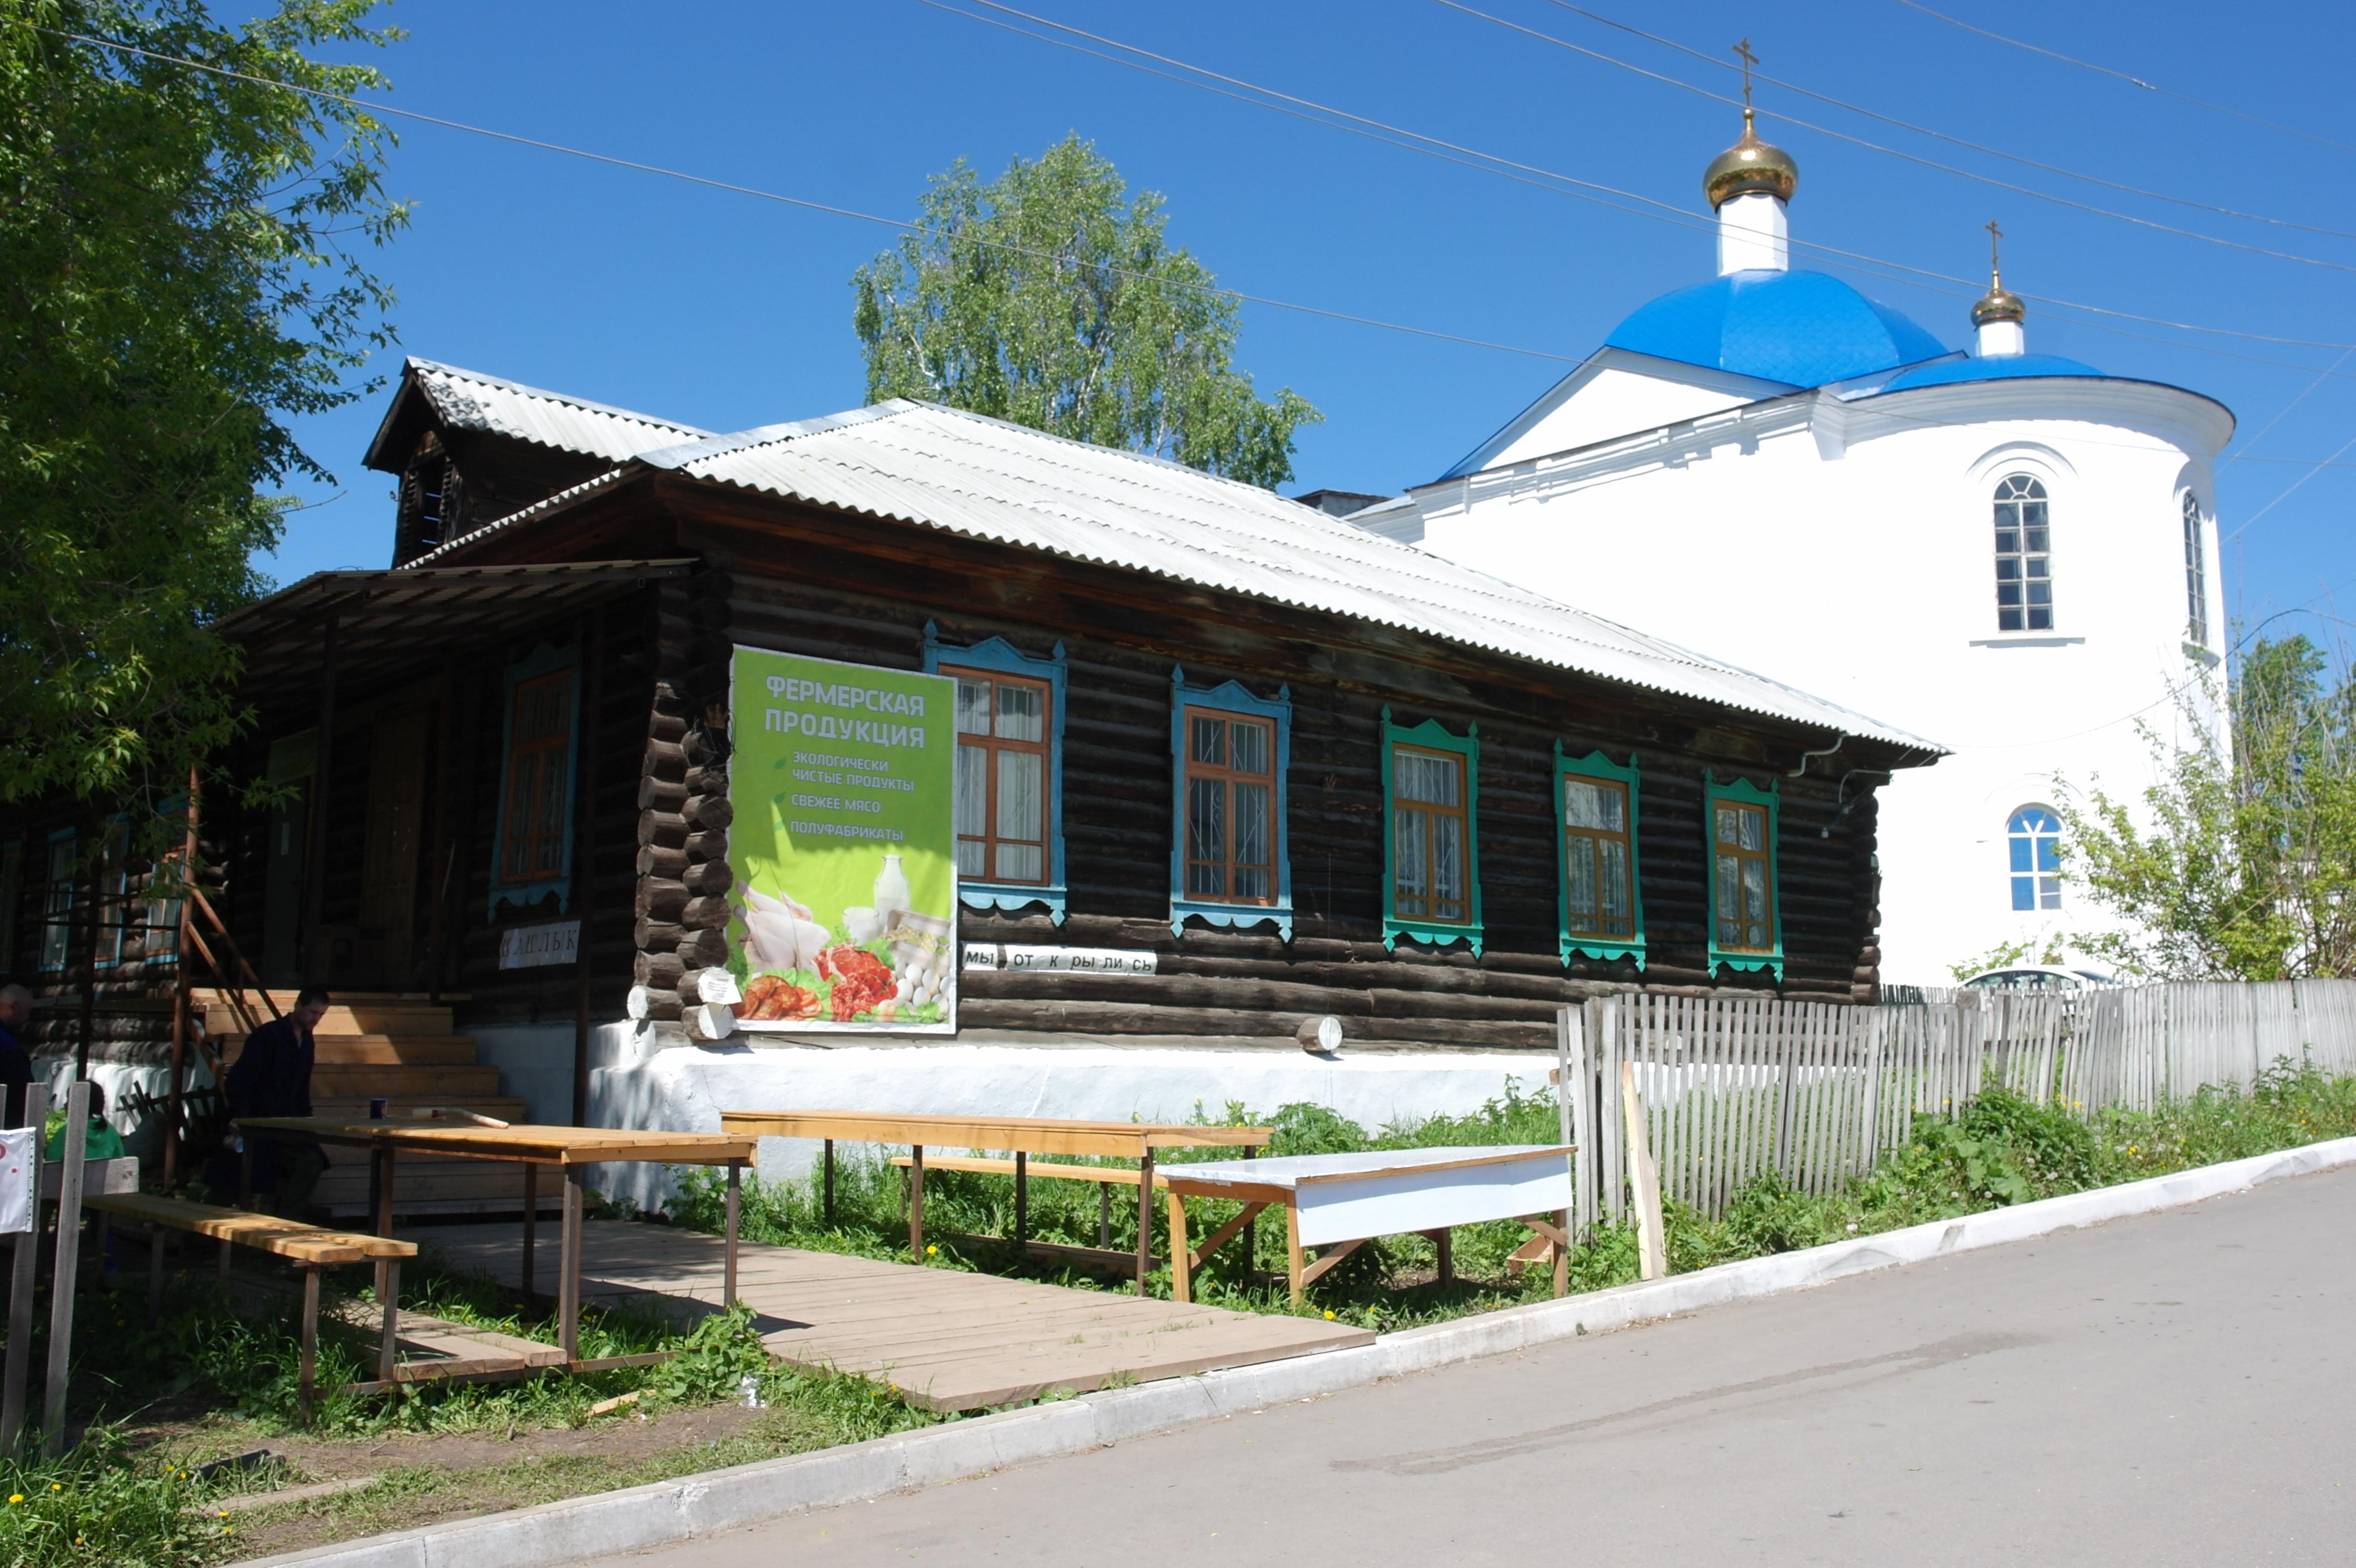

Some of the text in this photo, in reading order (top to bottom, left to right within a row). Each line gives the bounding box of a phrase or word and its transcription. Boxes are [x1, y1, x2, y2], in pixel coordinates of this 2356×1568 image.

[766, 676, 924, 717] ФЕРМЕРСКАЯ
[765, 709, 925, 748] ПРОДУКЦИЯ
[793, 752, 888, 772] ЭКОЛОГИЧЕСКИ
[793, 769, 914, 791] ЧИСТЫЕ ПРОДУКТЫ
[792, 794, 880, 813] СВЕЖЕЕ МЯСО
[791, 821, 904, 840] ПОЛУФАБРИКАТЫ
